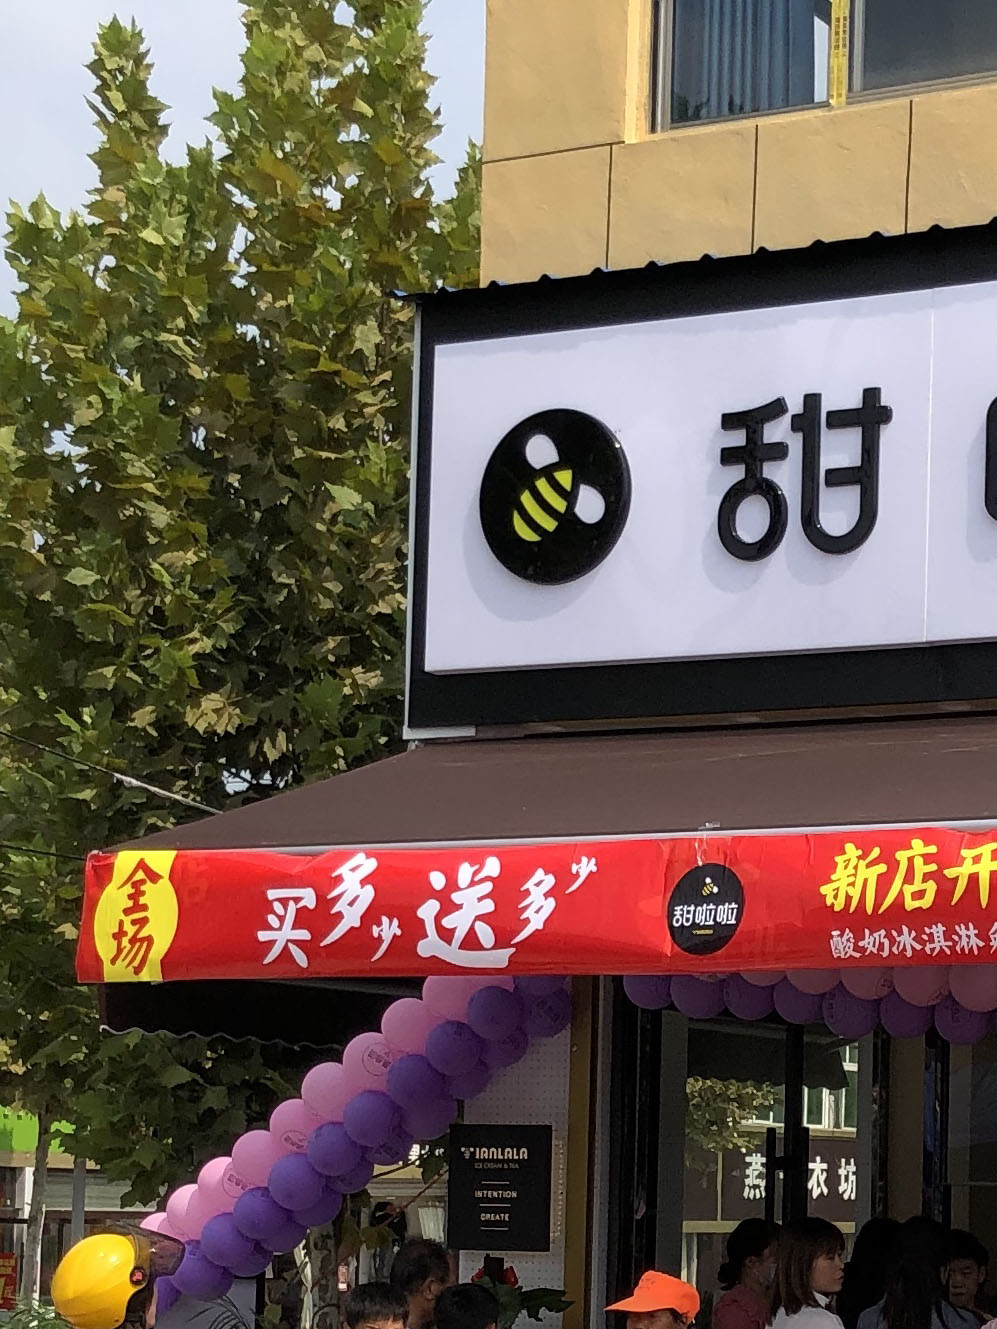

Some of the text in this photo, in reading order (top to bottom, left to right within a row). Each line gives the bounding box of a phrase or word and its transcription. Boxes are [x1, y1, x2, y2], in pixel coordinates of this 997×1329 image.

[109, 857, 164, 976] 全场
[256, 852, 598, 968] 买多少送多少
[672, 901, 738, 927] 甜啦啦
[743, 1153, 857, 1200] 燕衣坊
[480, 1213, 510, 1221] CREATE
